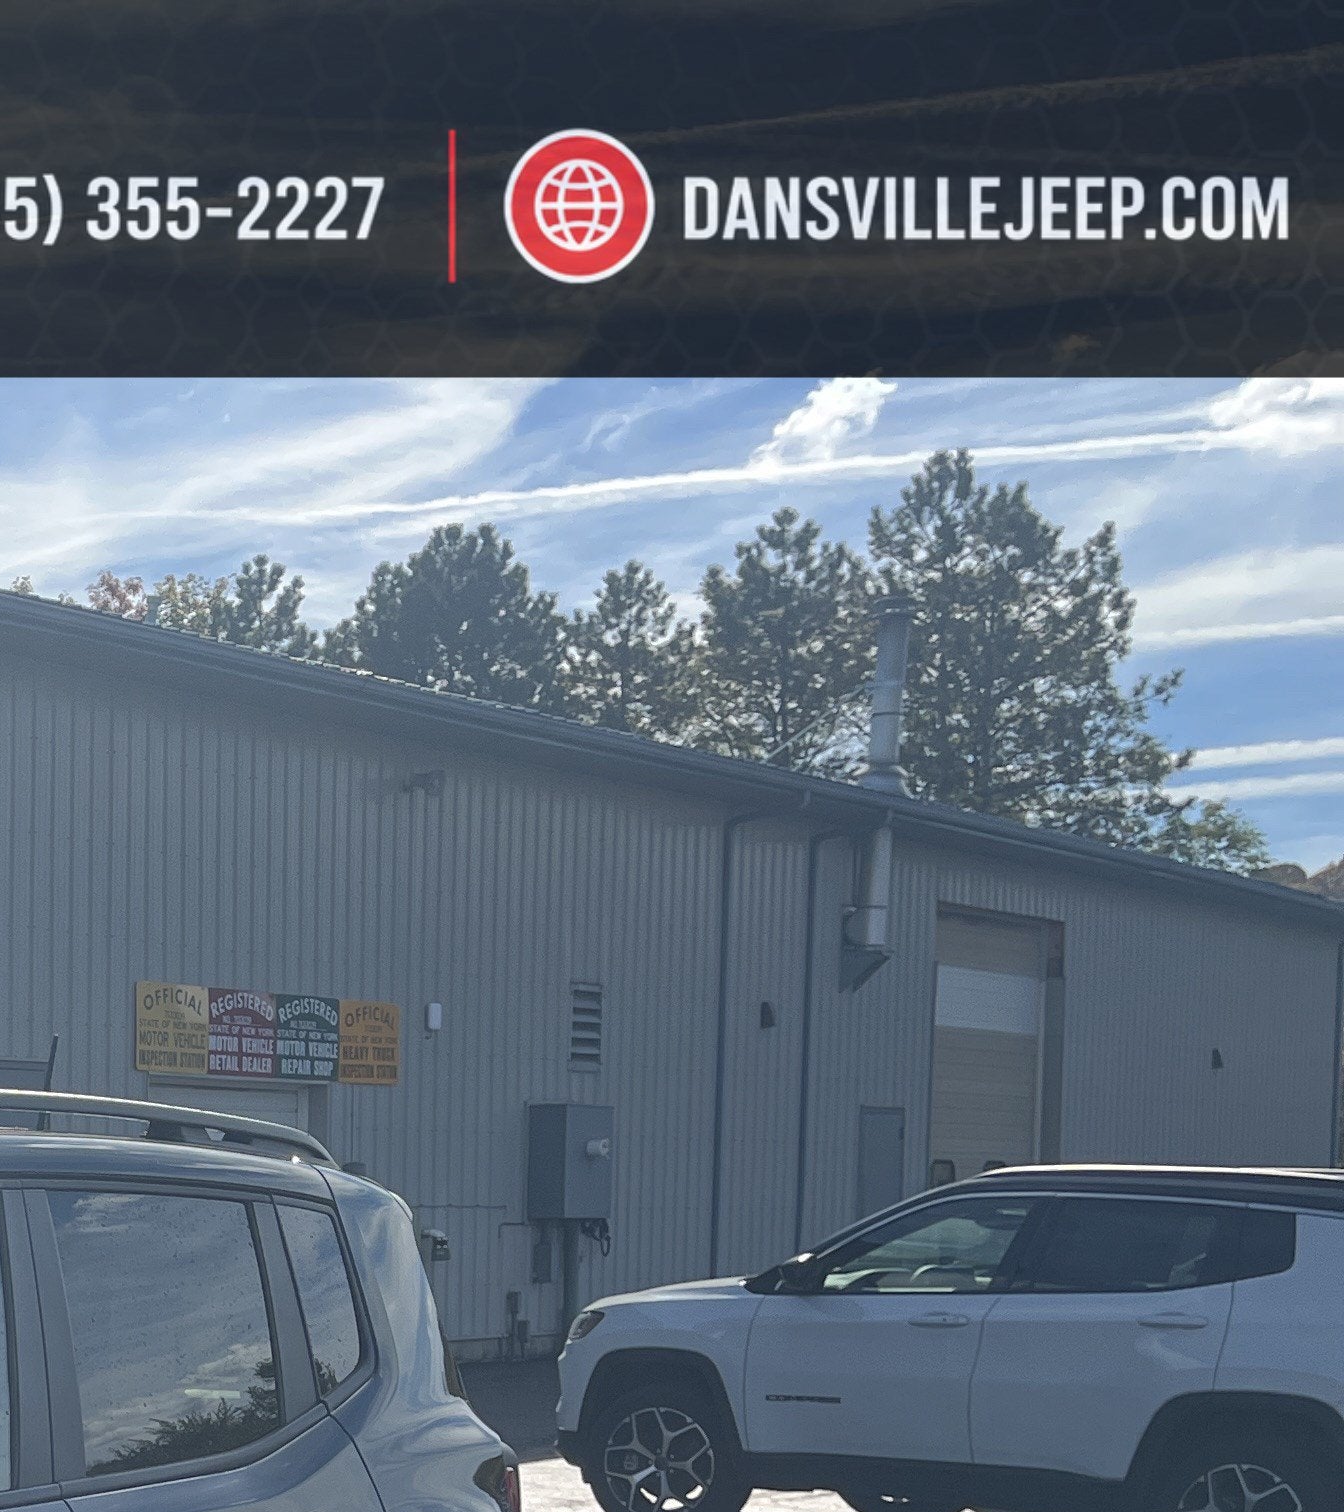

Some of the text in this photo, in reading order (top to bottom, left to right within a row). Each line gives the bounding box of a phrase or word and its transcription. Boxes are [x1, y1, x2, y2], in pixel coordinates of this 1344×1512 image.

[143, 987, 203, 1016] OFFICIAL
[210, 992, 274, 1021] REGISTERED
[277, 997, 338, 1026] REGISTERED
[344, 1006, 395, 1030] OFFICIAL
[139, 1029, 206, 1050] MOTOR VEHICLE
[208, 1034, 274, 1055] MOTOR VEHICLE
[276, 1040, 338, 1059] MOTOR VEHICLE
[209, 1054, 272, 1073] RETAIL DEALER
[281, 1058, 334, 1077] REPAIR SHOP
